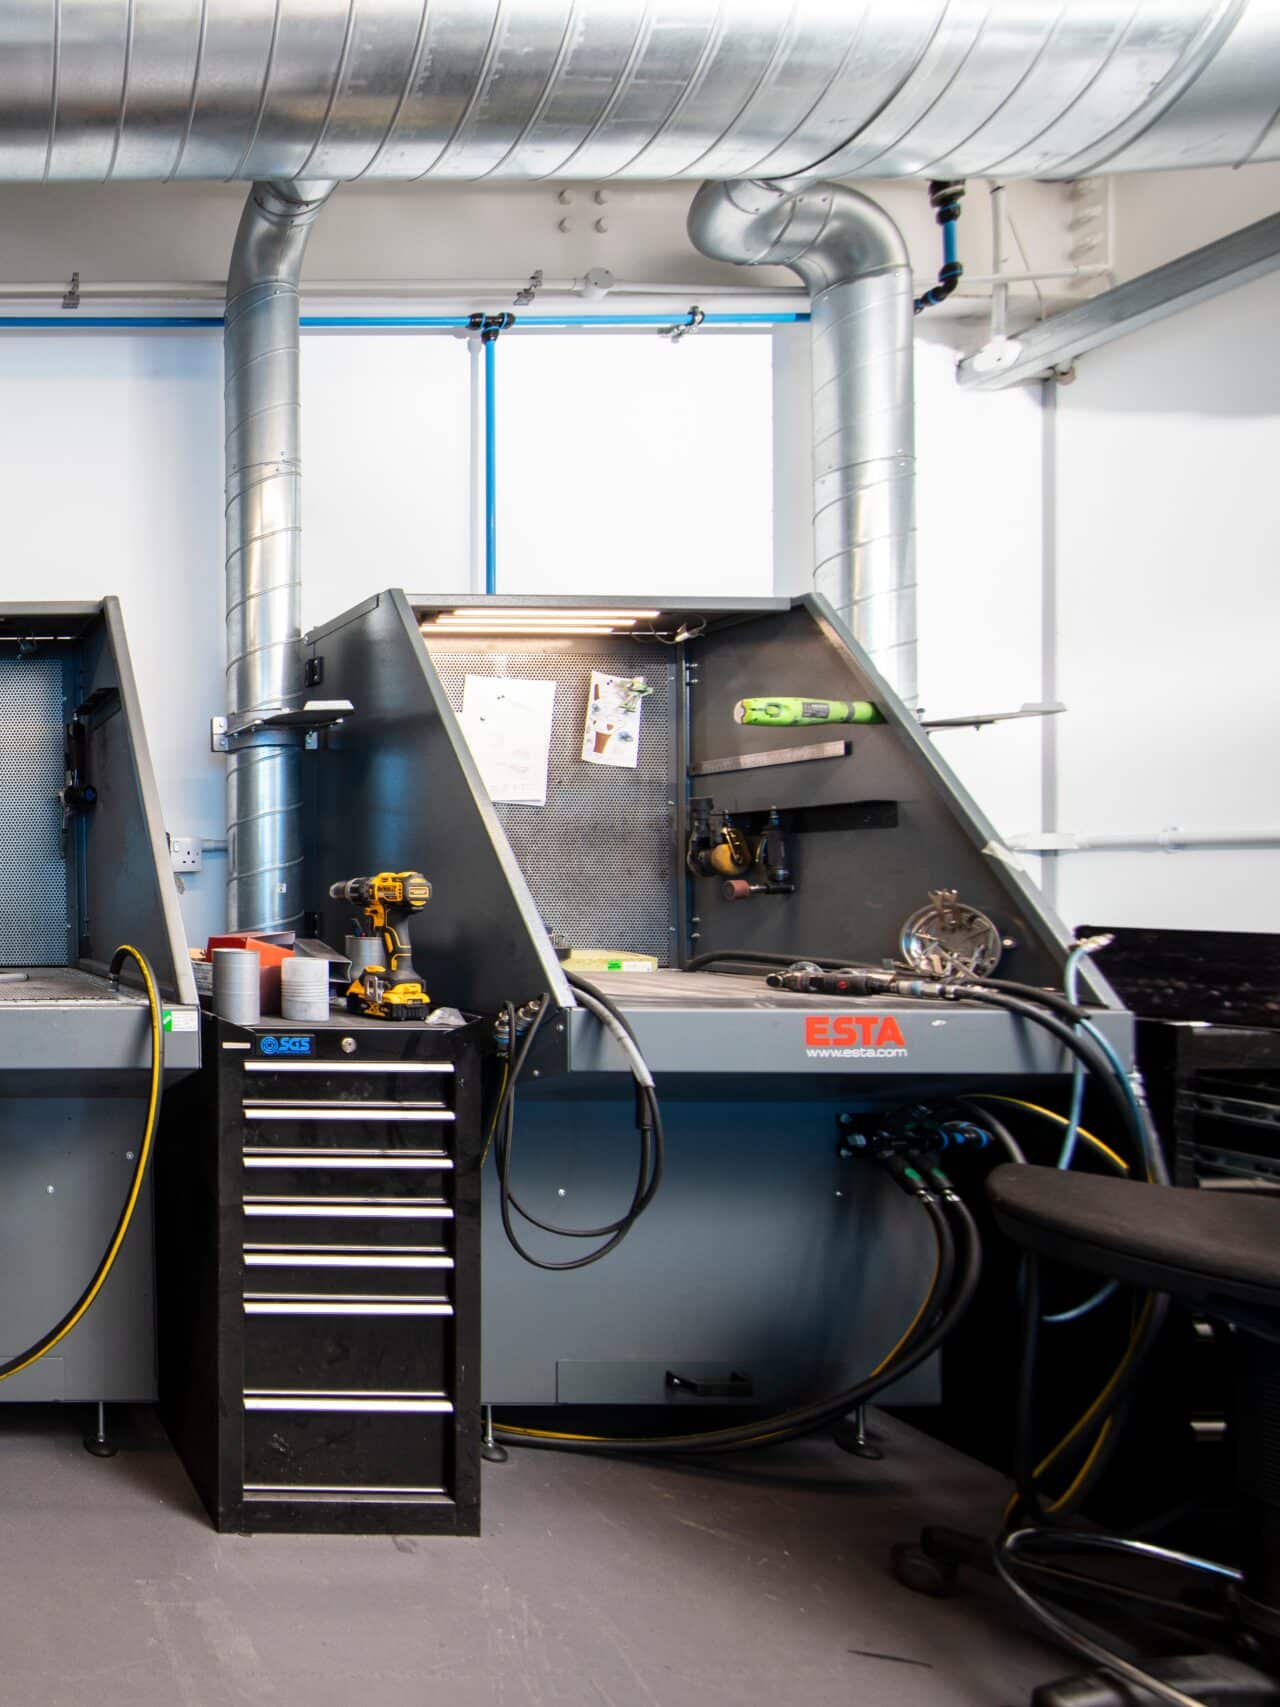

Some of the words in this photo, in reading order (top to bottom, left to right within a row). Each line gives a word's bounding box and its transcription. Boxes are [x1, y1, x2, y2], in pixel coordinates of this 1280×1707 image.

[805, 1014, 906, 1047] ESTA
[279, 1036, 311, 1051] SGS
[806, 1047, 908, 1058] www.esta.com
